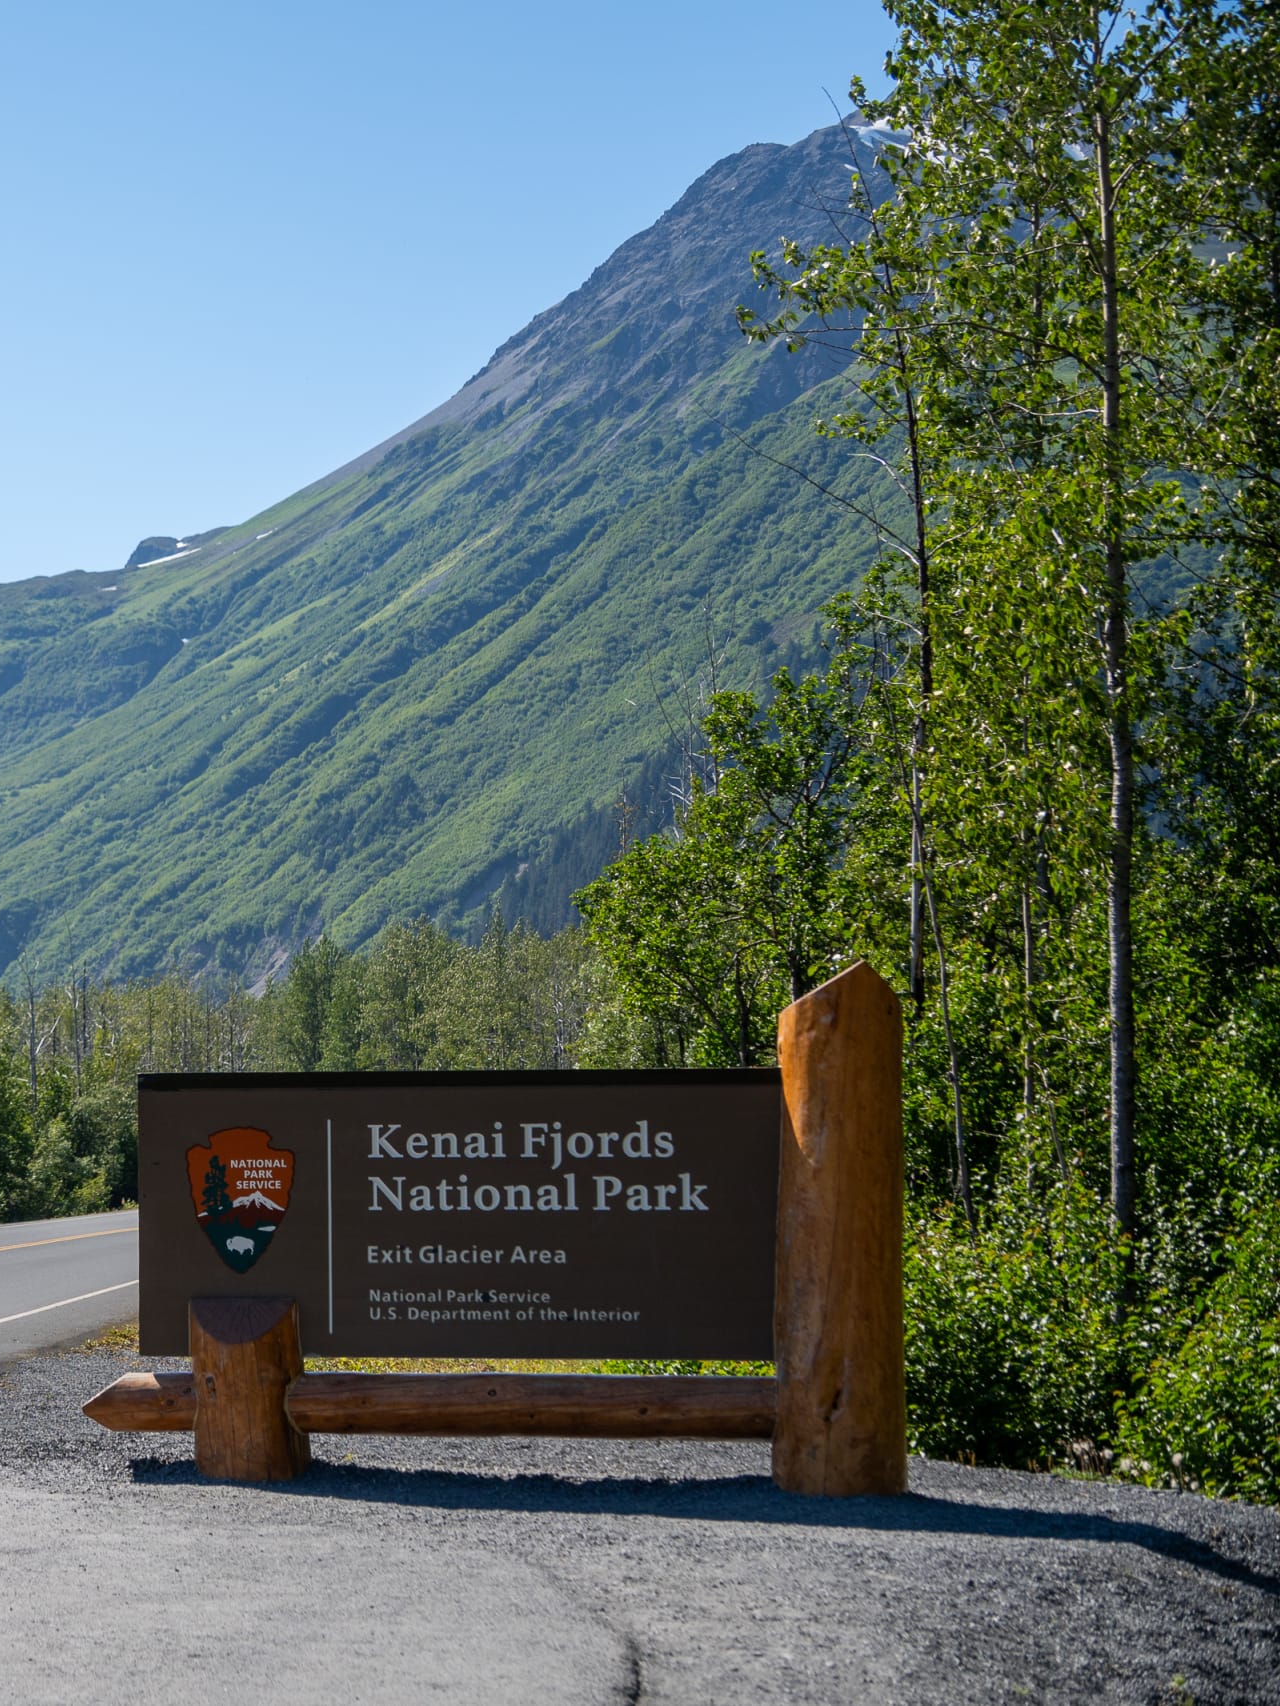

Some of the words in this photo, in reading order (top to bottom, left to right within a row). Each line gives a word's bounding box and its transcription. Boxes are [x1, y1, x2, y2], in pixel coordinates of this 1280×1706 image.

[368, 1122, 506, 1158] Kenai
[520, 1120, 674, 1170] Fjords
[230, 1159, 288, 1169] NATIONAL
[243, 1169, 273, 1179] PARK
[235, 1180, 282, 1190] SERVICE
[368, 1173, 579, 1211] National
[592, 1173, 709, 1211] Park
[368, 1245, 412, 1263] Exit
[419, 1245, 504, 1263] Glacier
[511, 1246, 566, 1263] Area
[370, 1289, 441, 1302] National
[447, 1289, 483, 1302] Park
[489, 1290, 550, 1303] Service
[370, 1307, 402, 1320] U.S.
[408, 1307, 509, 1323] Department
[516, 1307, 533, 1320] of
[540, 1308, 568, 1320] the
[574, 1308, 640, 1321] Interior
